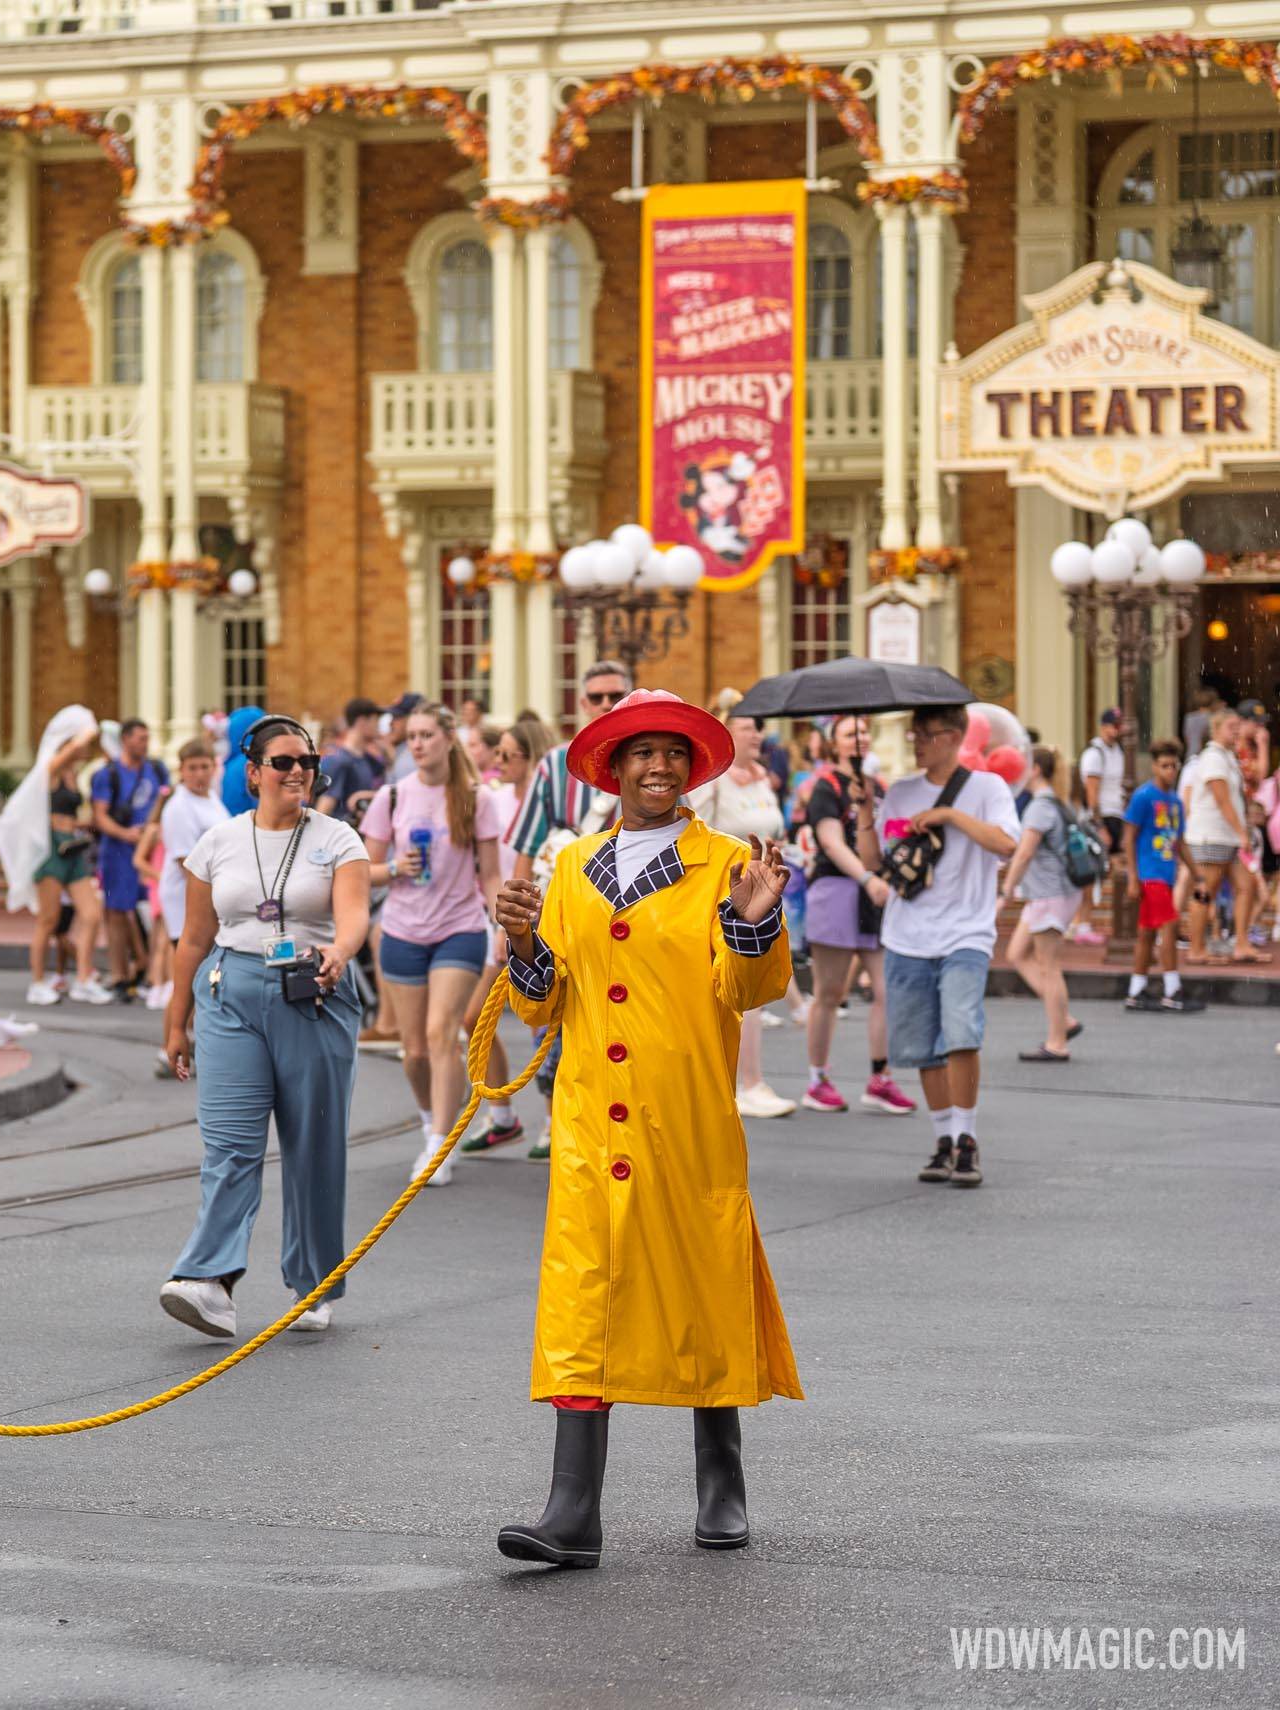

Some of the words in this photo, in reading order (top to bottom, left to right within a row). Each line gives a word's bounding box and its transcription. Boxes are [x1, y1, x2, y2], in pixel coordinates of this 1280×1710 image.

[678, 310, 792, 361] MAGICIAN
[1044, 333, 1100, 370] TOWN
[1103, 324, 1192, 369] SQUARE
[654, 372, 792, 429] MICKEY
[985, 382, 1250, 439] THEATER
[671, 412, 774, 452] MOUSE
